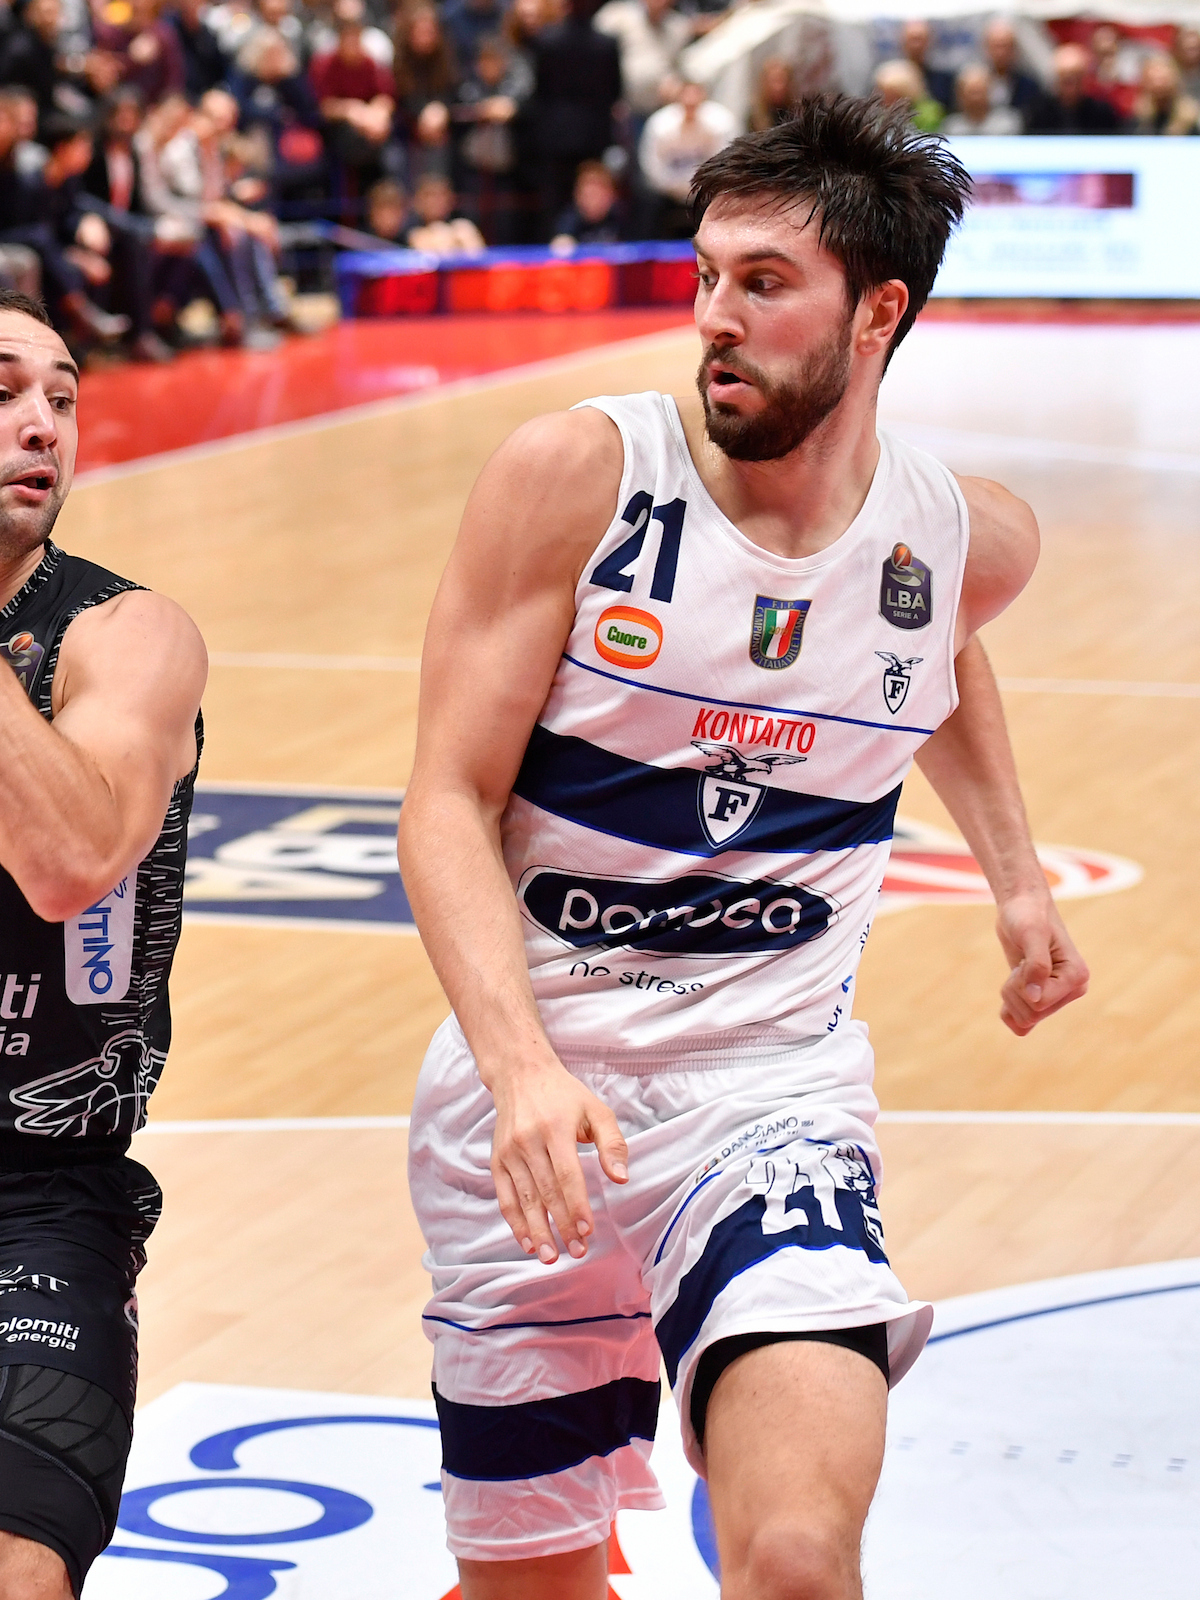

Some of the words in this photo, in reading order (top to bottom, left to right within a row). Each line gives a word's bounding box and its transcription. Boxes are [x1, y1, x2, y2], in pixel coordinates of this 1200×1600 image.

[589, 490, 687, 603] 21
[886, 588, 926, 611] LBA
[893, 610, 912, 619] SERIE
[912, 612, 919, 620] A
[607, 625, 648, 650] Cuore
[888, 680, 905, 699] F
[691, 708, 816, 754] KONTATTO
[708, 786, 750, 823] F
[569, 962, 611, 978] no
[5, 1331, 78, 1352] energia
